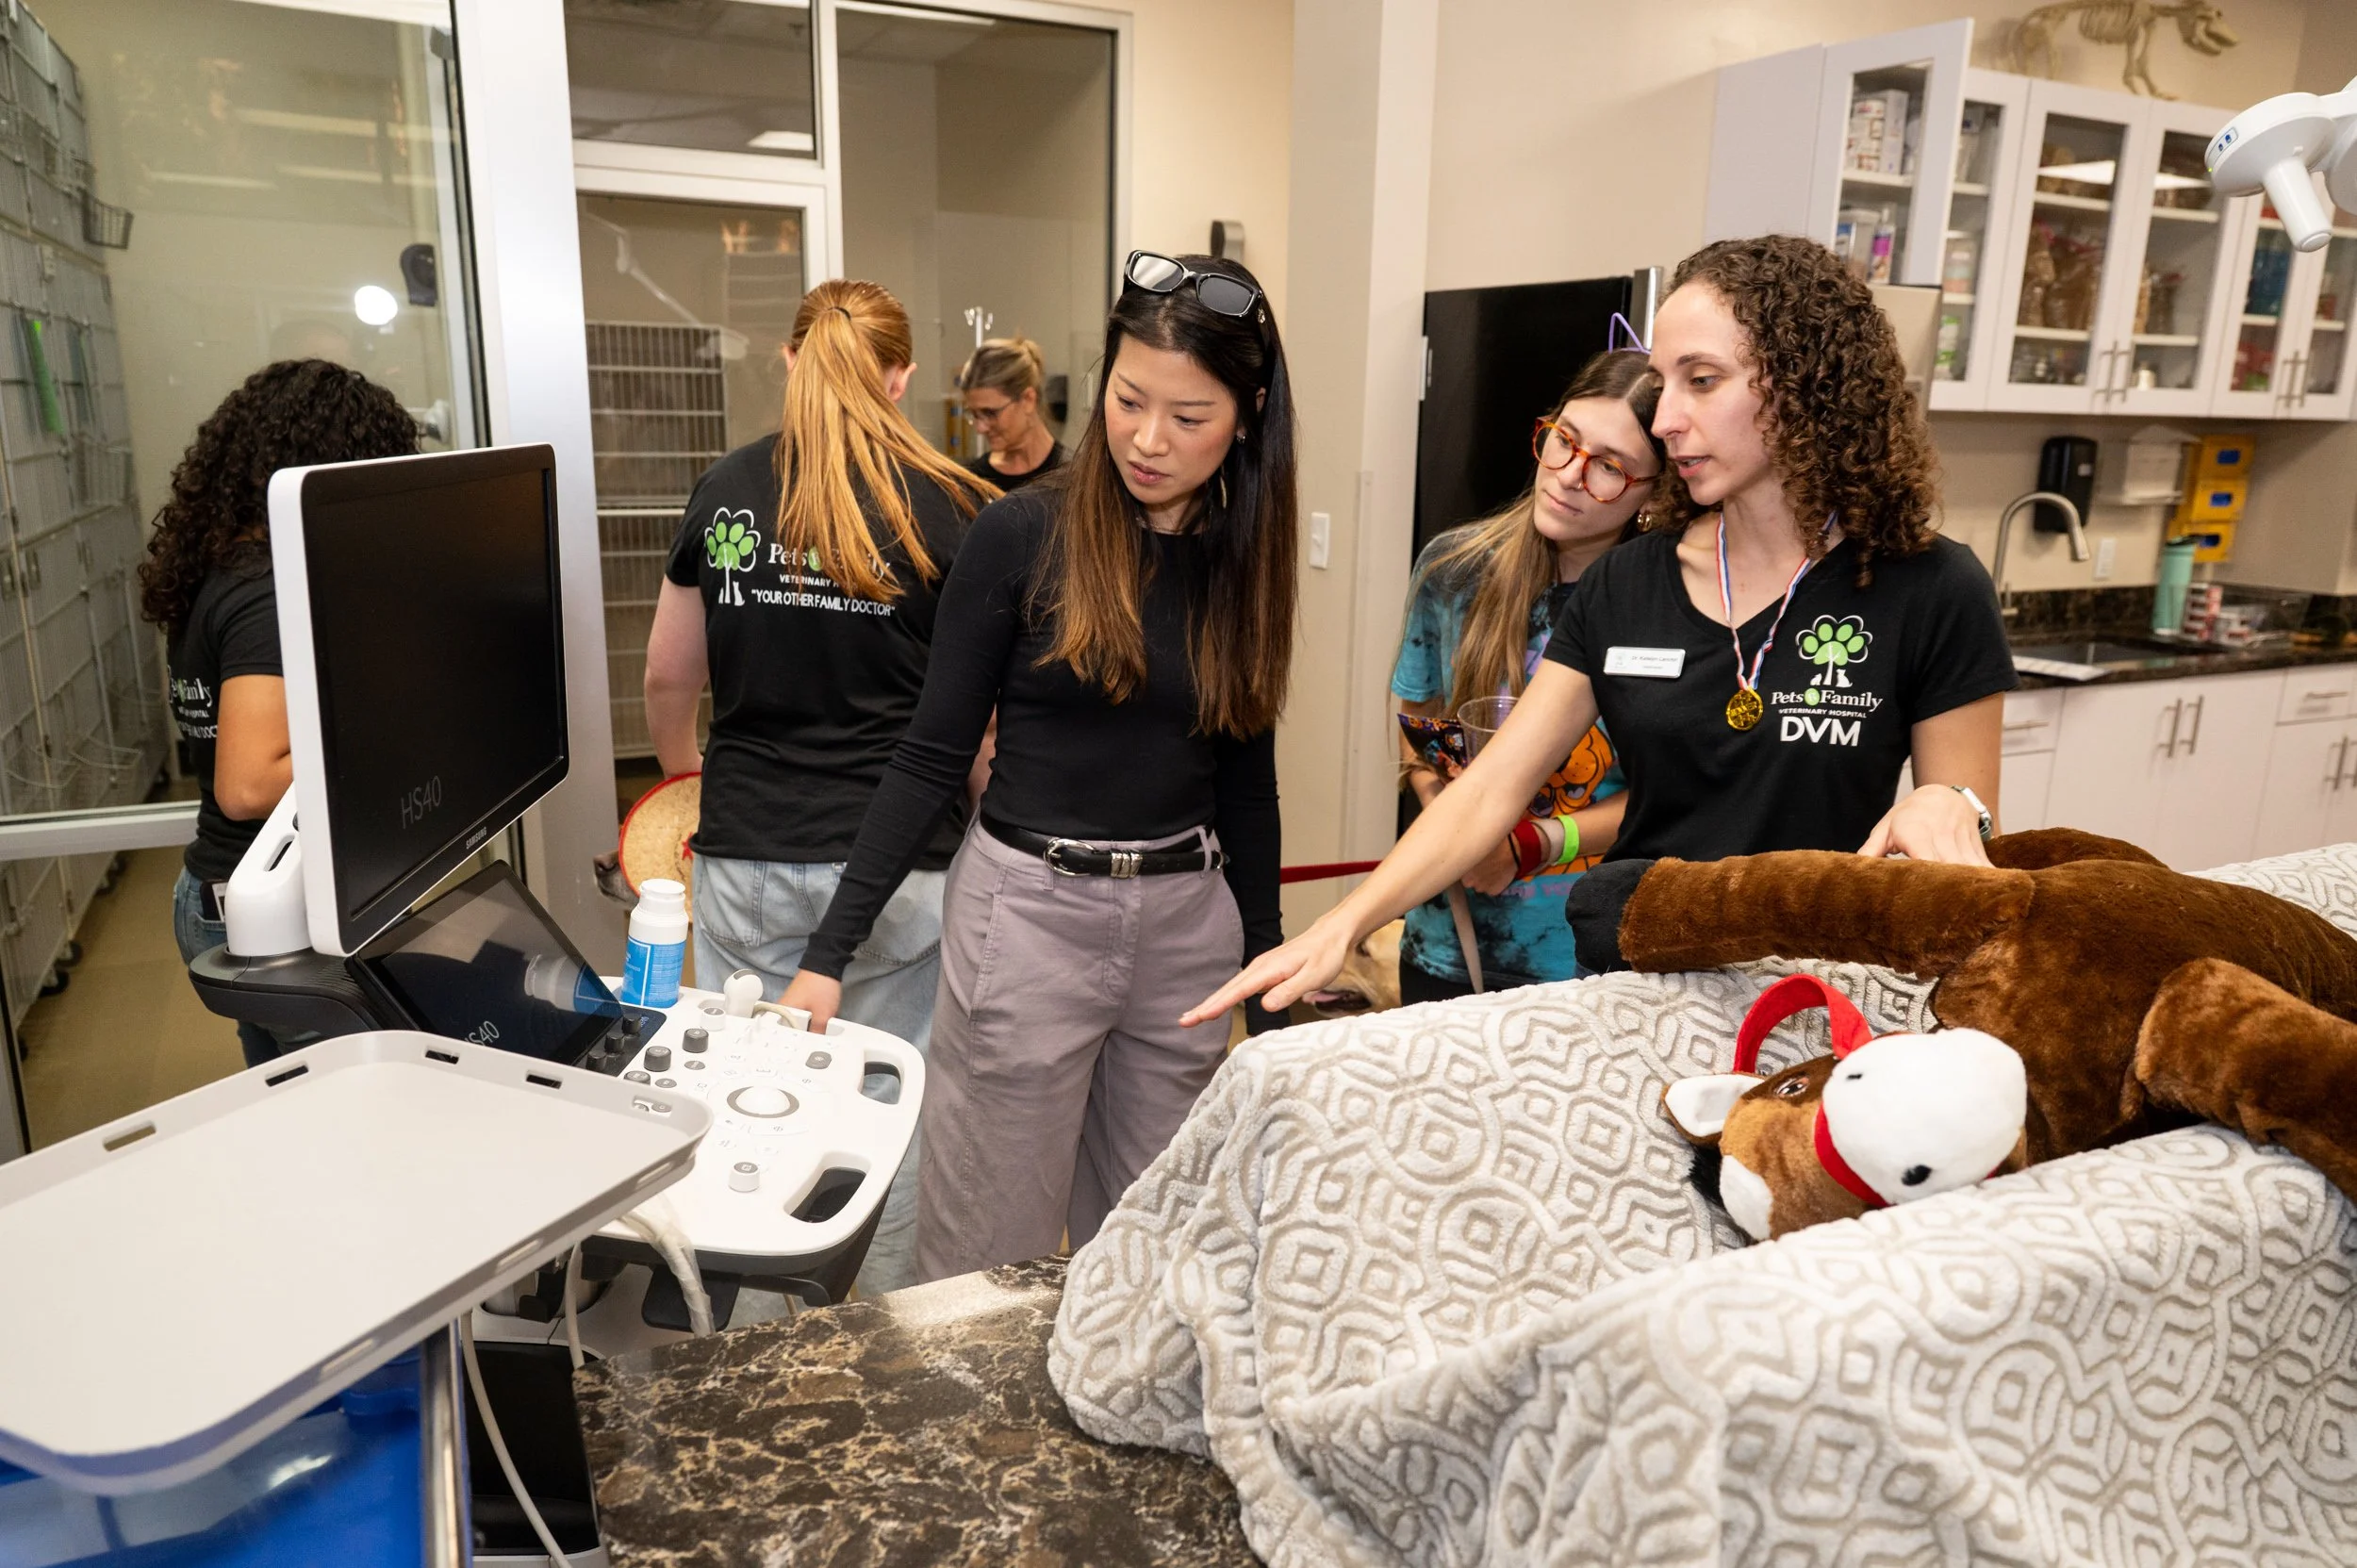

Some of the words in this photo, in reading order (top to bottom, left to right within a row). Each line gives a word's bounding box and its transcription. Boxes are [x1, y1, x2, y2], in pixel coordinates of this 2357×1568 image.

[767, 543, 809, 566] Pets
[780, 574, 832, 586] VETERINARY
[751, 588, 783, 604] "YOUR
[783, 592, 814, 606] OTHER
[815, 594, 849, 611] FAMILY
[850, 600, 895, 616] DOCTOR"
[1772, 691, 1805, 705] Pets
[1820, 689, 1883, 712] Family
[1829, 709, 1867, 718] HOSPITAL
[1780, 717, 1861, 747] DVM
[401, 775, 441, 829] HS40
[466, 826, 486, 850] SAMSUNG
